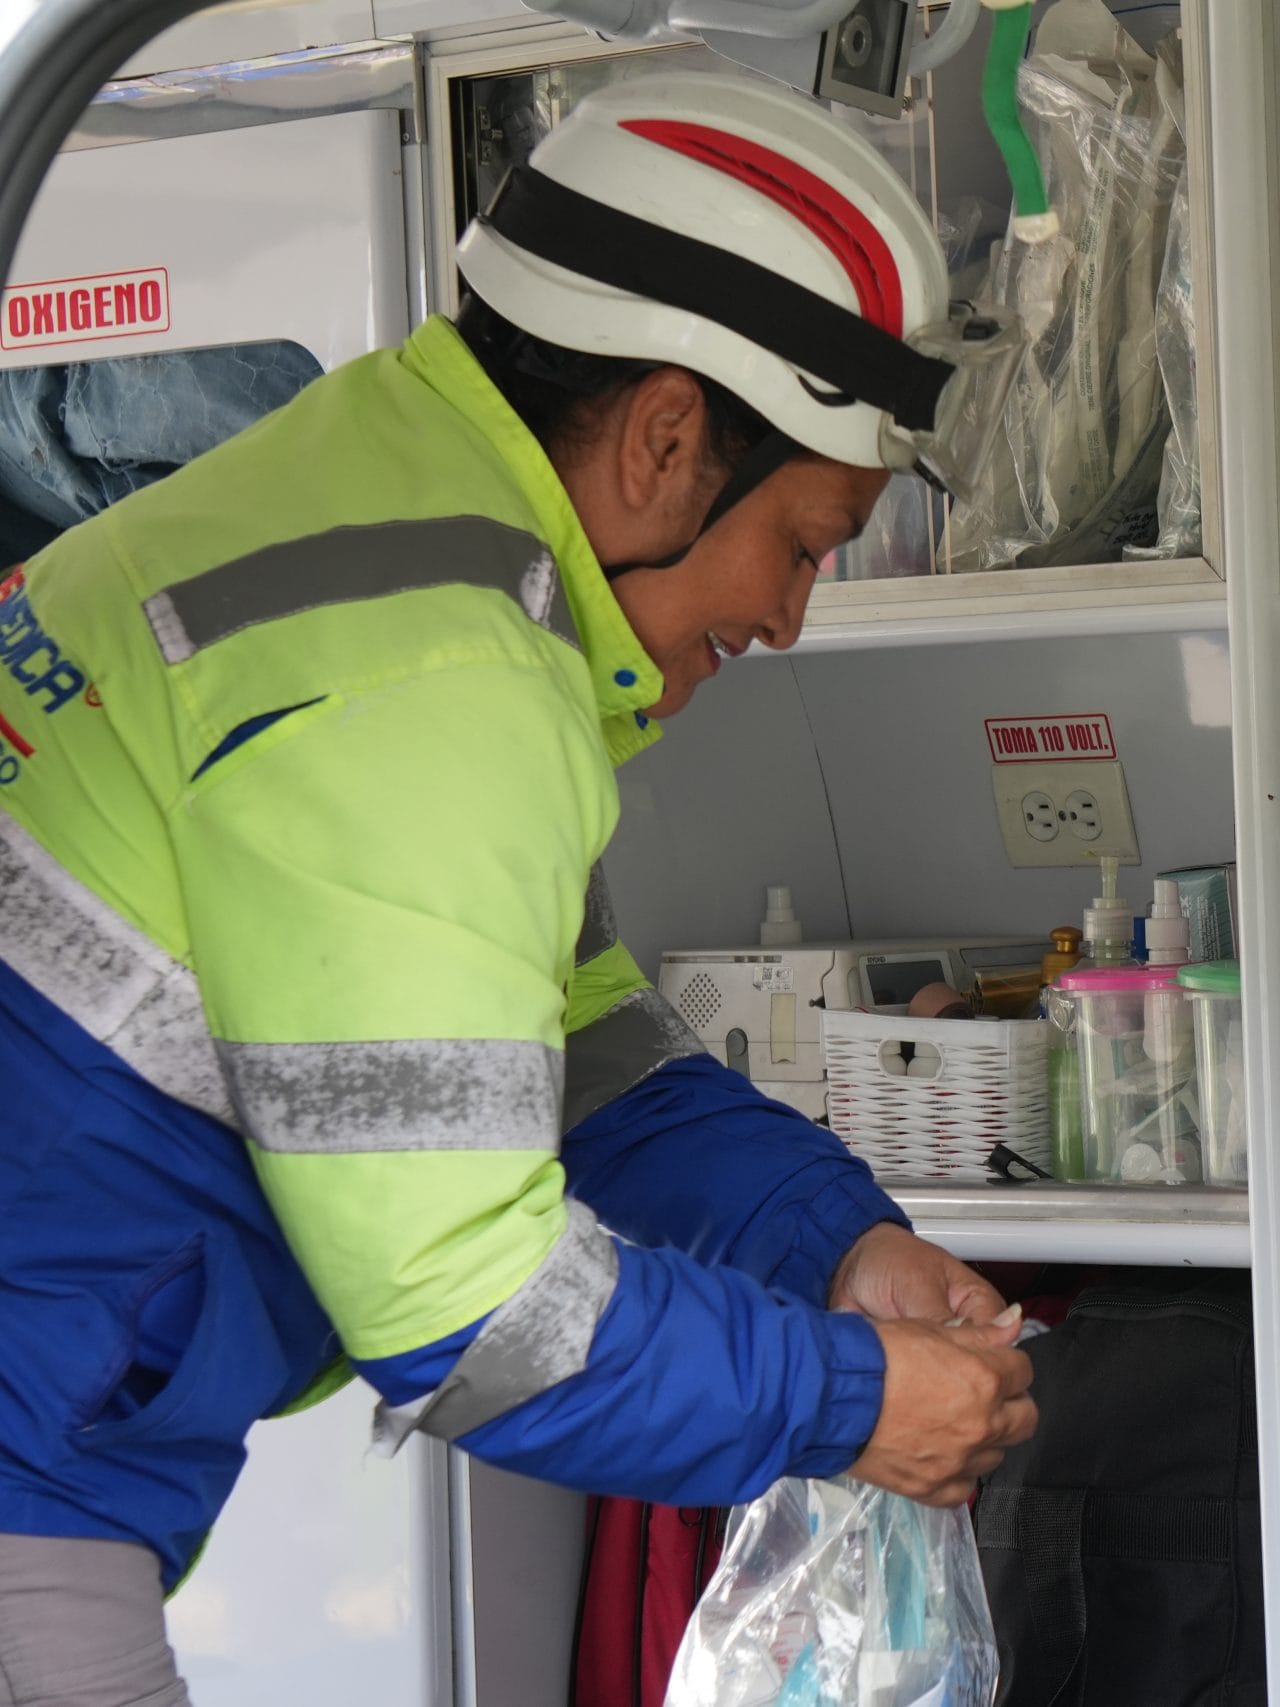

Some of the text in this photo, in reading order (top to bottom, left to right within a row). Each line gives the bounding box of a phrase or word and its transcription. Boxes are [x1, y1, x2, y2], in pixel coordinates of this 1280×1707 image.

[8, 280, 162, 338] OXIGENO
[992, 723, 1109, 754] TOMA 110 VOLT.
